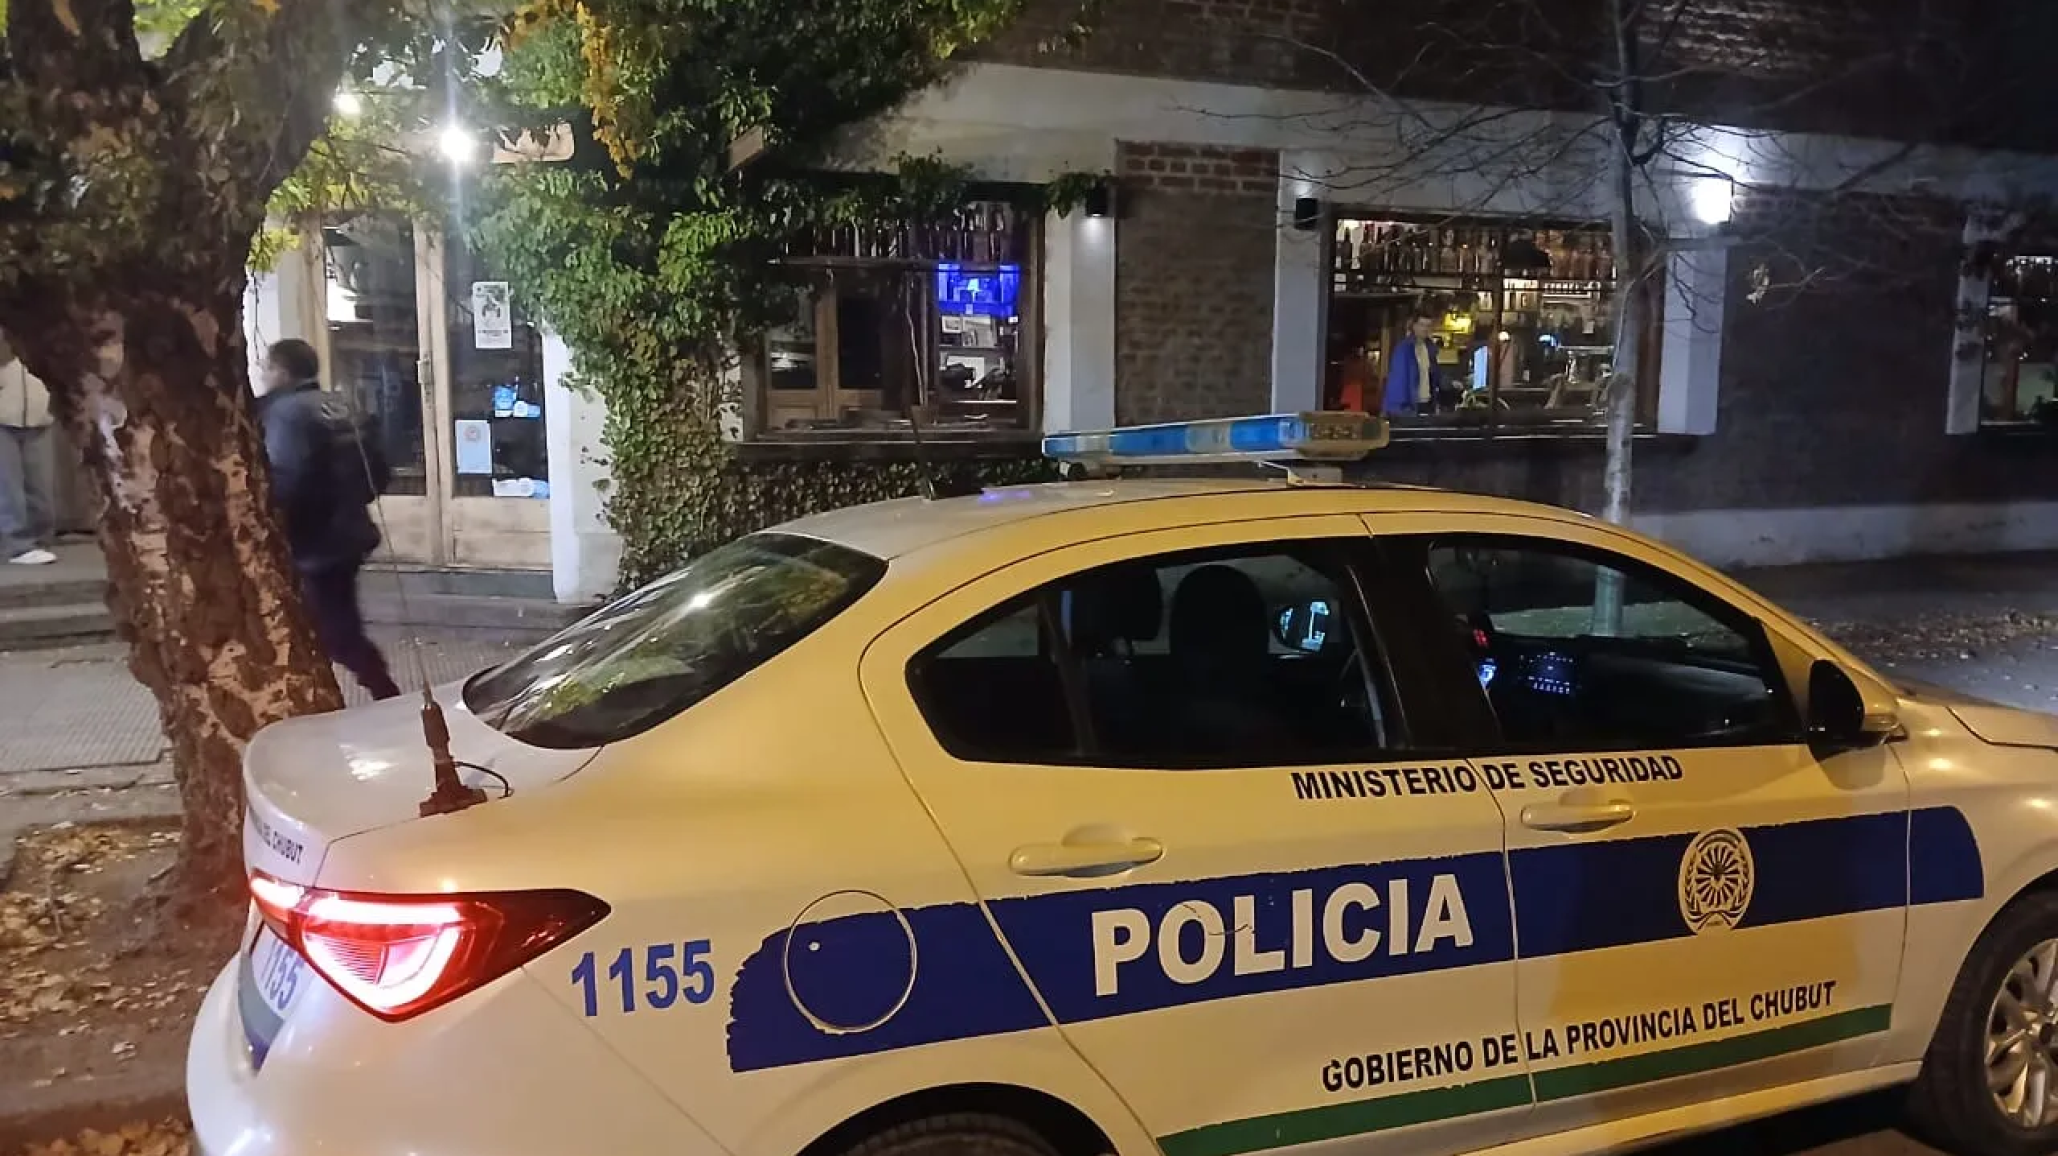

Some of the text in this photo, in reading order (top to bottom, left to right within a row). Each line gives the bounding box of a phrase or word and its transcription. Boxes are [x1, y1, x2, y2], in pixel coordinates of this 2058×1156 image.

[1291, 755, 1684, 799] MINISTERIO DE SEGURIDAD
[1091, 873, 1474, 997] POLICIA
[260, 939, 305, 1011] 1155
[571, 939, 715, 1017] 1155
[1322, 980, 1837, 1092] GOBIERNO DE LA PROVINCIA DEL CHUBUT
